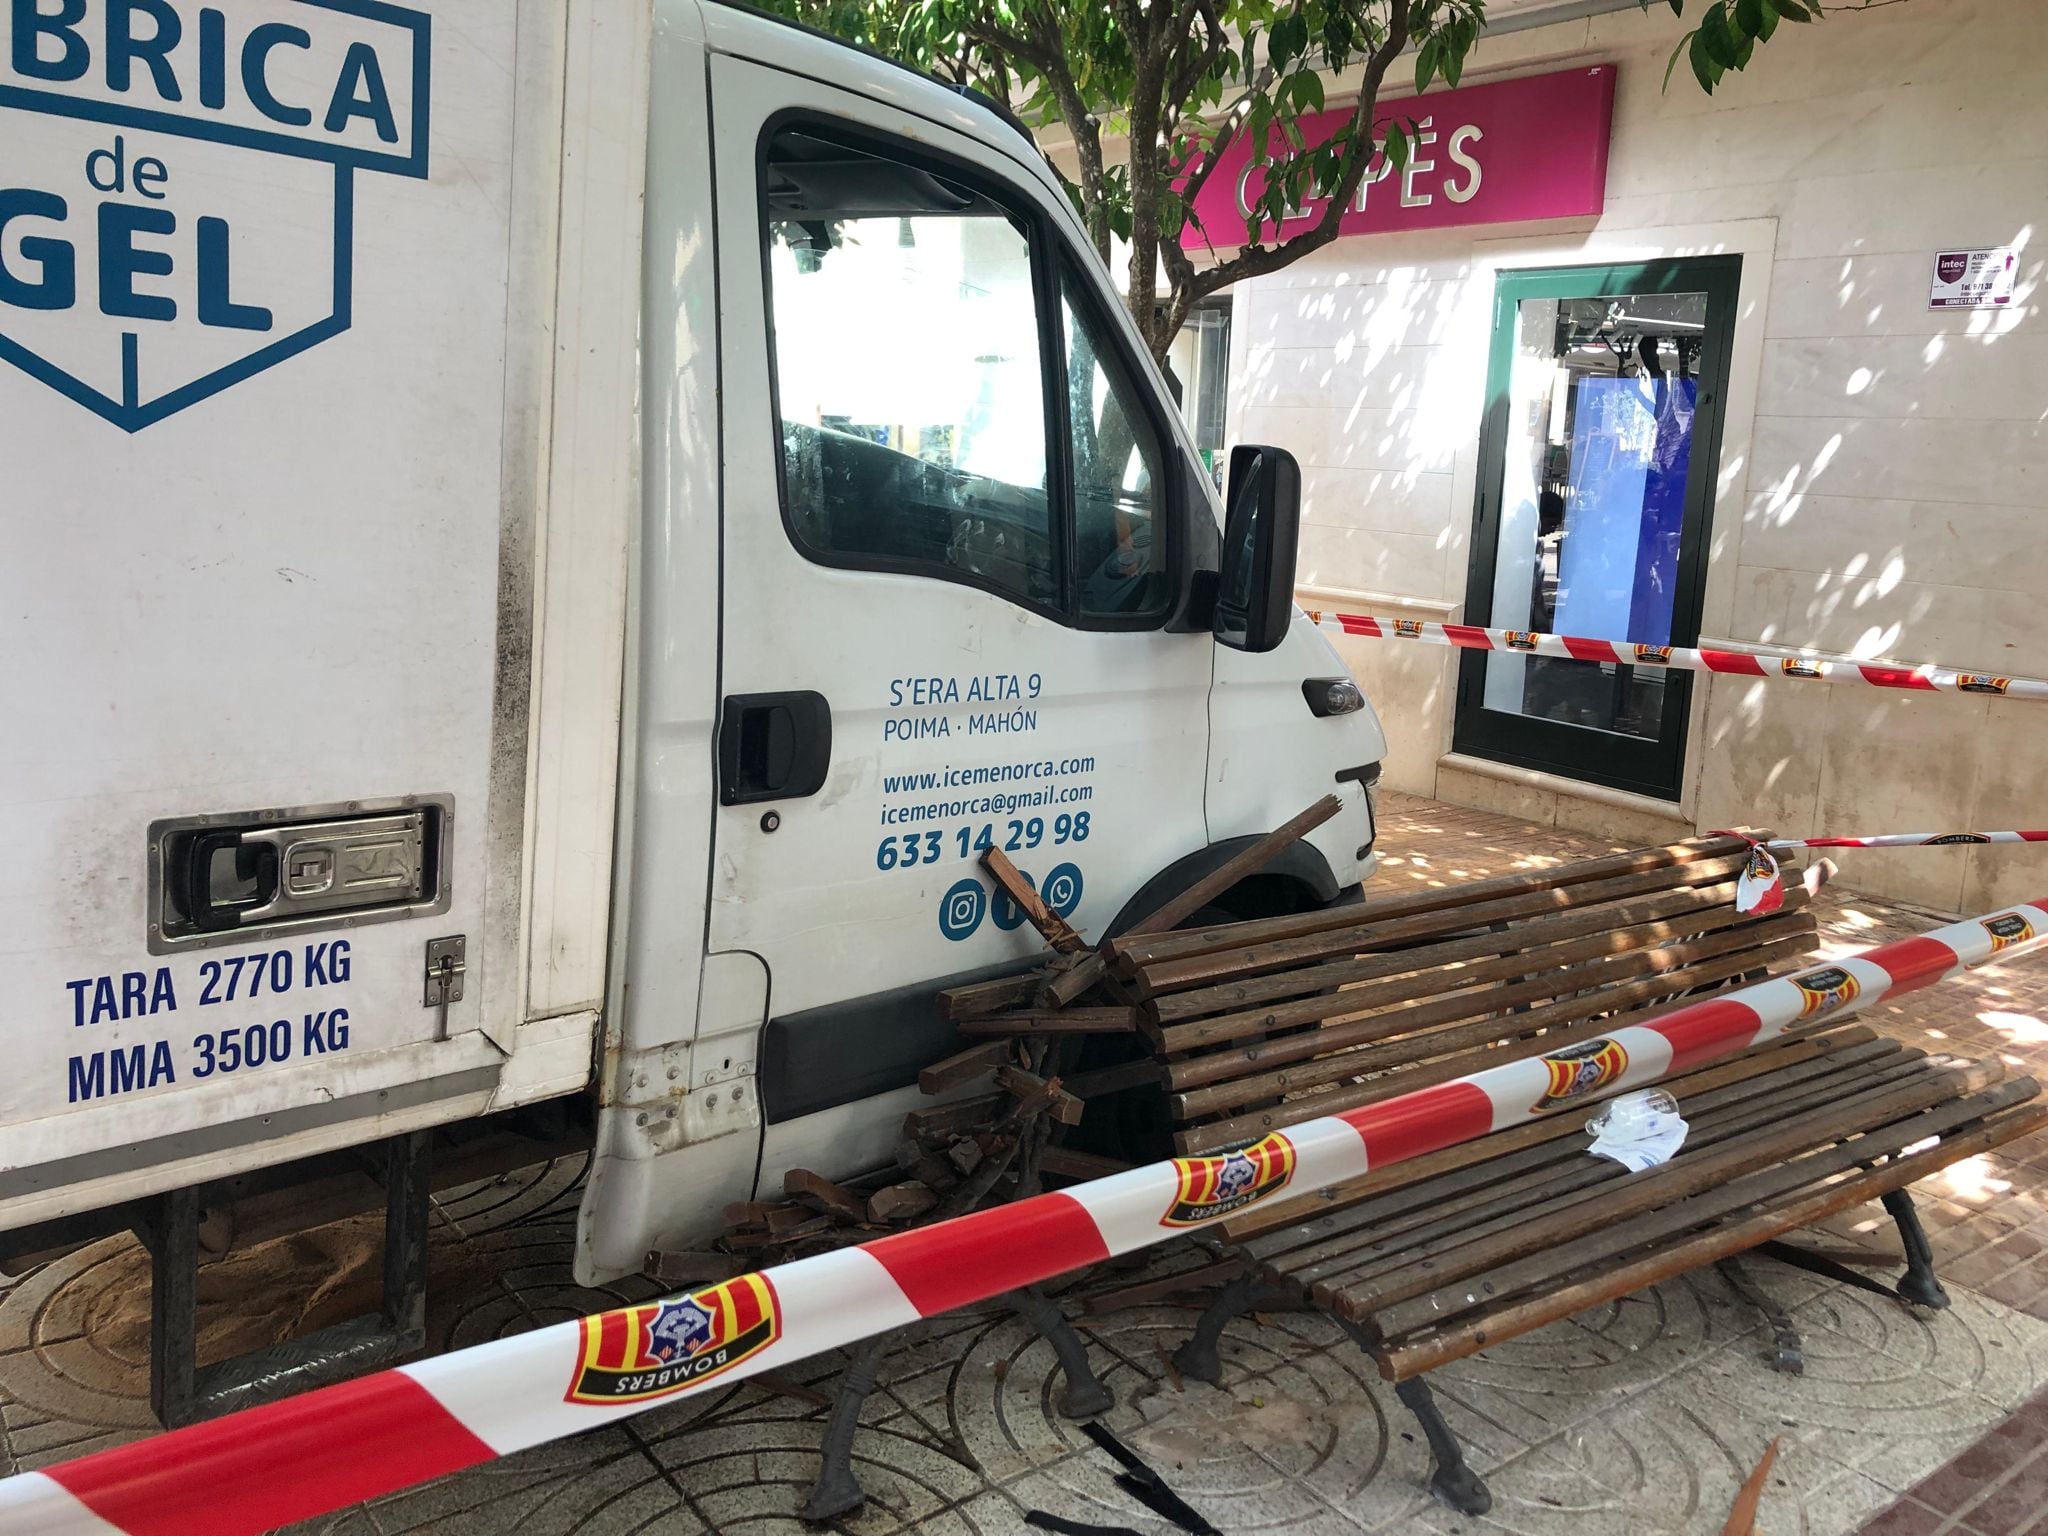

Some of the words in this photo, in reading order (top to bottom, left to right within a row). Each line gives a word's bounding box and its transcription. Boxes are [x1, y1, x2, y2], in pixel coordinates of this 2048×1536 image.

[12, 0, 399, 144] BRICA
[86, 135, 169, 199] de
[0, 188, 273, 332] GEL
[1941, 260, 1965, 269] intec
[967, 674, 1021, 702] ALTA
[1028, 673, 1042, 699] 9
[884, 716, 951, 742] POIMA
[969, 706, 1037, 735] MAHÓN
[884, 756, 1095, 793] www.icemenorca.com
[881, 785, 1093, 825] icemenorca@gmail.com
[877, 830, 943, 871] 633
[956, 824, 994, 858] 14
[1004, 817, 1044, 852] 29
[1054, 811, 1091, 845] 98
[1936, 835, 1975, 845] BOMBERS
[66, 967, 177, 1027] TARA
[199, 950, 293, 1006] 2770
[304, 940, 352, 988] KG
[68, 1040, 176, 1103] MMA
[193, 1019, 292, 1078] 3500
[303, 1008, 350, 1056] KG
[1188, 1190, 1258, 1220] BOMBERS
[615, 1349, 728, 1394] BOMBERS
